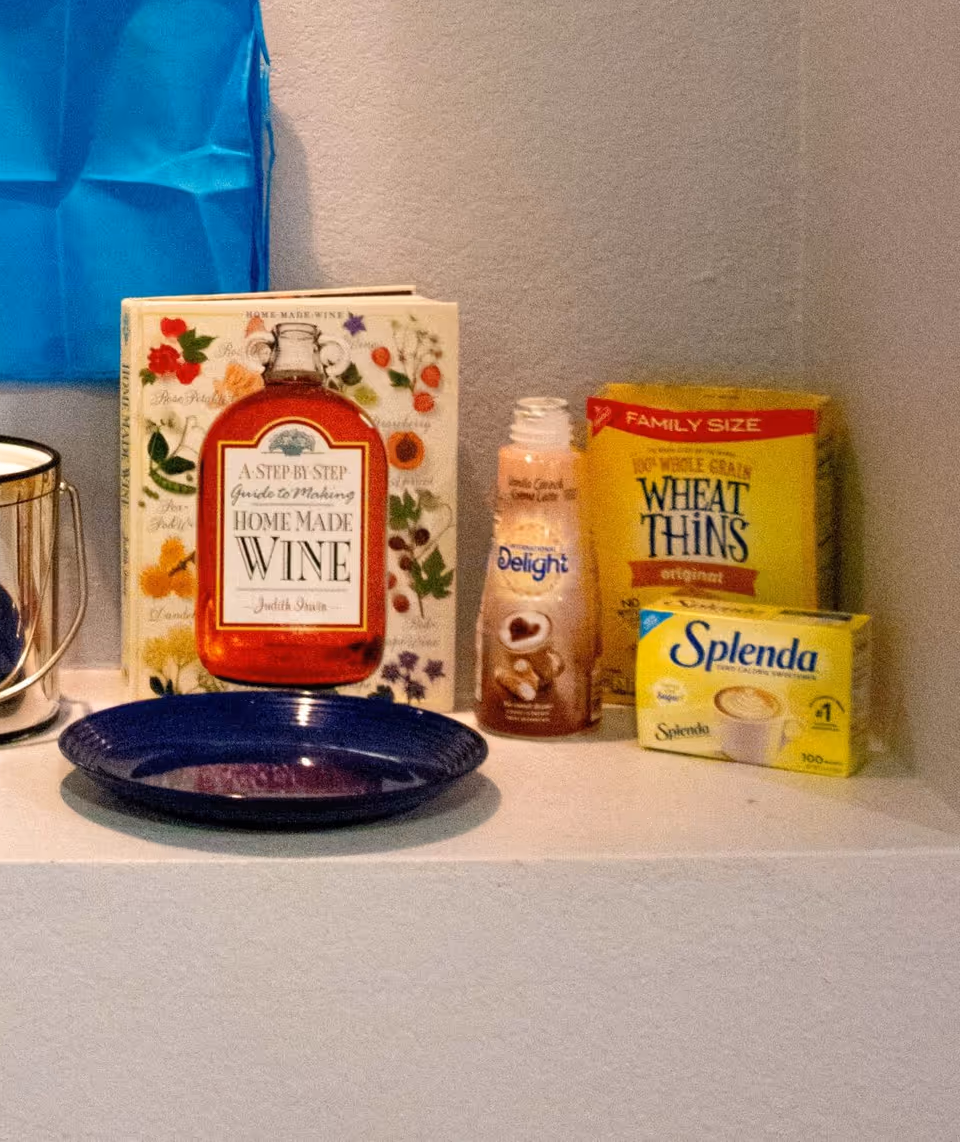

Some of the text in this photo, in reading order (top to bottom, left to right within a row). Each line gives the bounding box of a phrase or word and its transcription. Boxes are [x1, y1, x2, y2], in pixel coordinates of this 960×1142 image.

[626, 411, 702, 432] FAMILY
[707, 417, 762, 432] SIZE
[660, 457, 704, 473] WHOLE
[709, 458, 752, 479] GRAIN
[230, 483, 355, 506] Guide to Making
[636, 475, 750, 517] WHEAT
[233, 510, 353, 532] HOME MADE
[233, 536, 352, 583] WINE
[497, 545, 569, 581] Delight
[661, 567, 723, 584] original
[253, 596, 291, 614] Judith
[669, 620, 819, 672] Splenda
[655, 722, 710, 741] Splenda
[801, 753, 824, 764] 100
